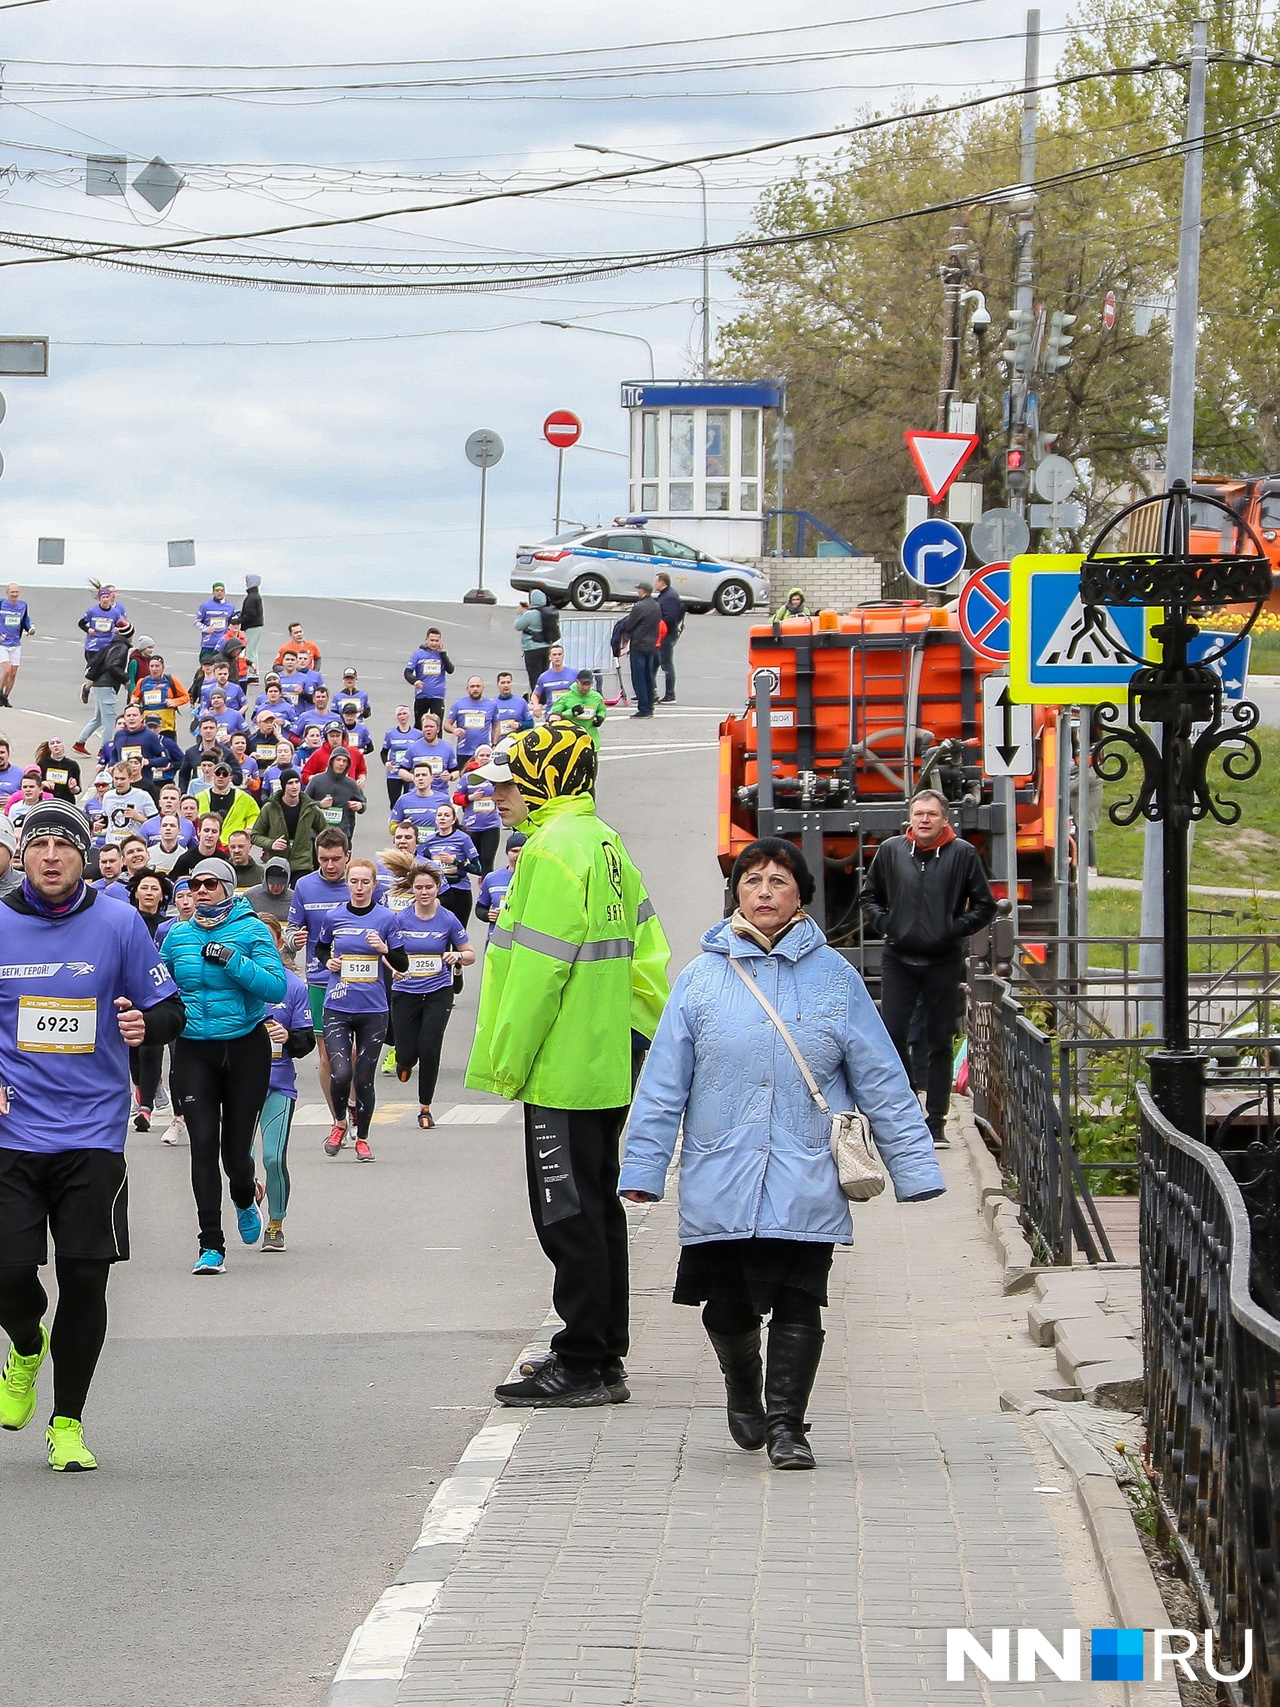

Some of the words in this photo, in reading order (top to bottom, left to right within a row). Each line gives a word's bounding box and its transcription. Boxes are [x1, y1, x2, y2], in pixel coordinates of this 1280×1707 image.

[350, 964, 371, 972] 5128
[416, 960, 435, 968] 3256
[2, 968, 21, 977] БЕГИ,
[24, 966, 50, 975] ГЕРОЙ!
[331, 989, 347, 1000] RUN
[36, 1016, 79, 1032] 6923
